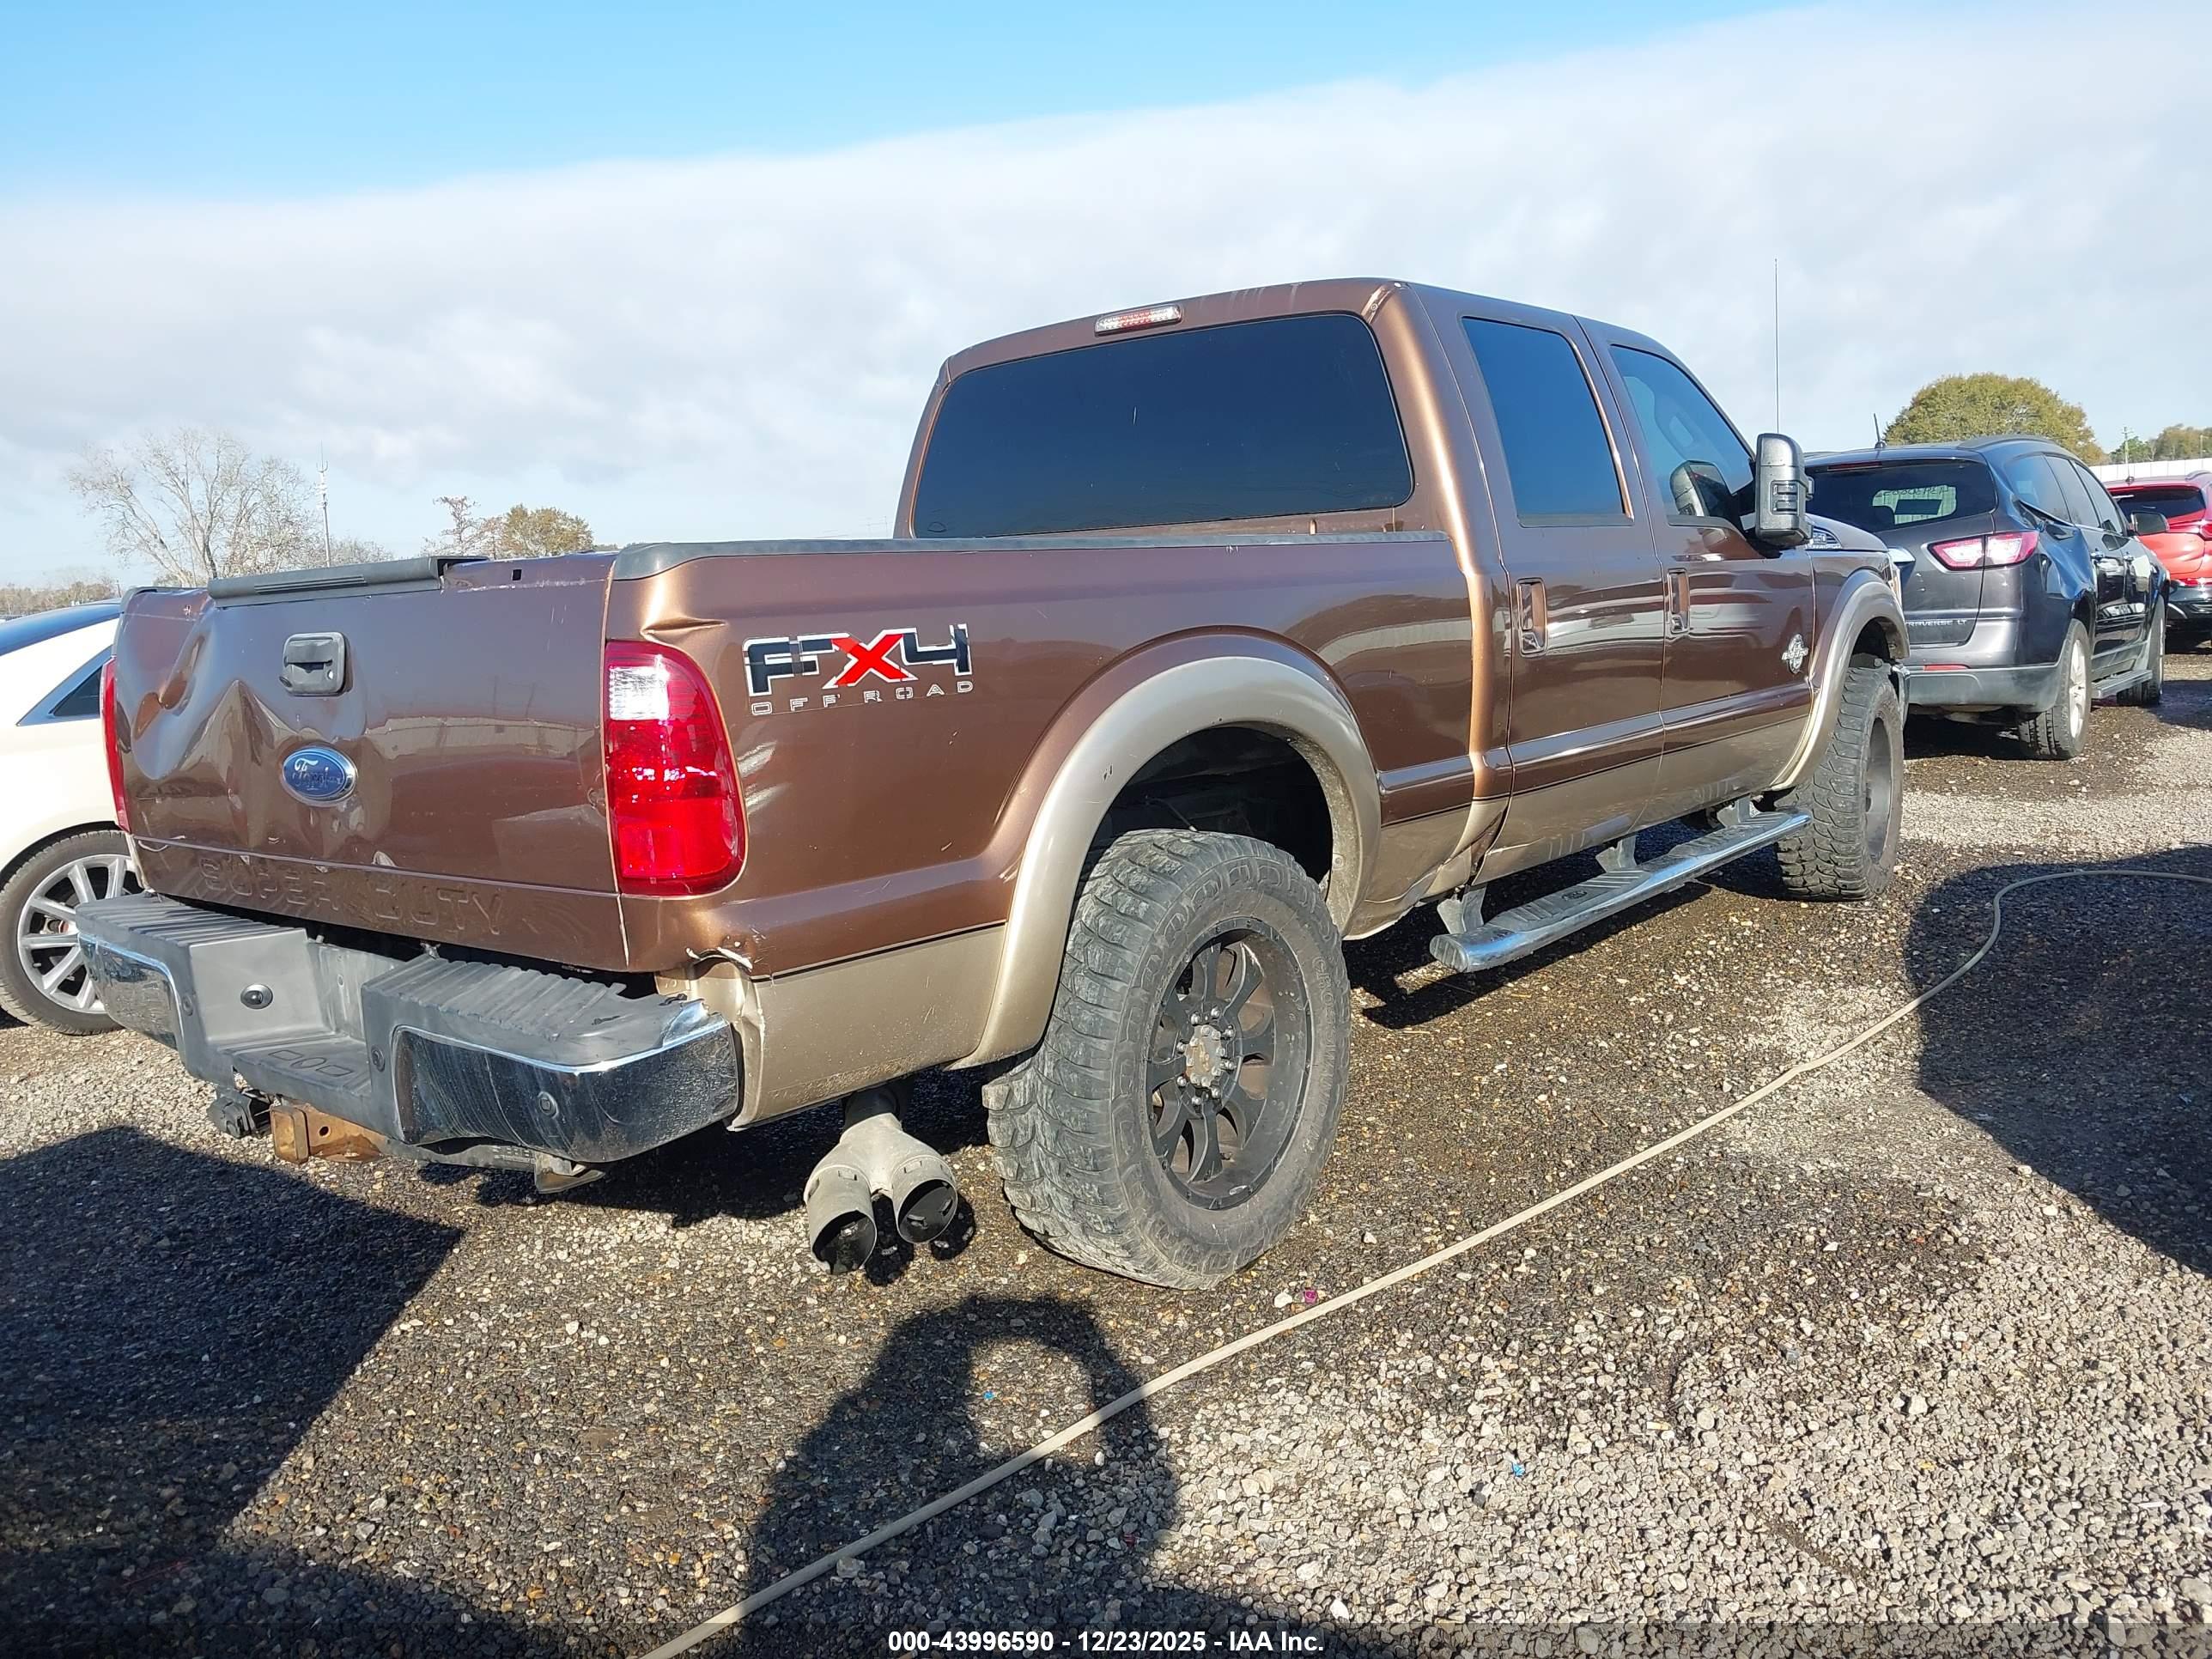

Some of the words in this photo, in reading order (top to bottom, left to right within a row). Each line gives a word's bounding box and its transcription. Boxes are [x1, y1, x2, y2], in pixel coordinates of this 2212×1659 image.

[863, 681, 974, 703] ROAD
[199, 855, 340, 912] SUPER
[372, 879, 501, 936] DUTY
